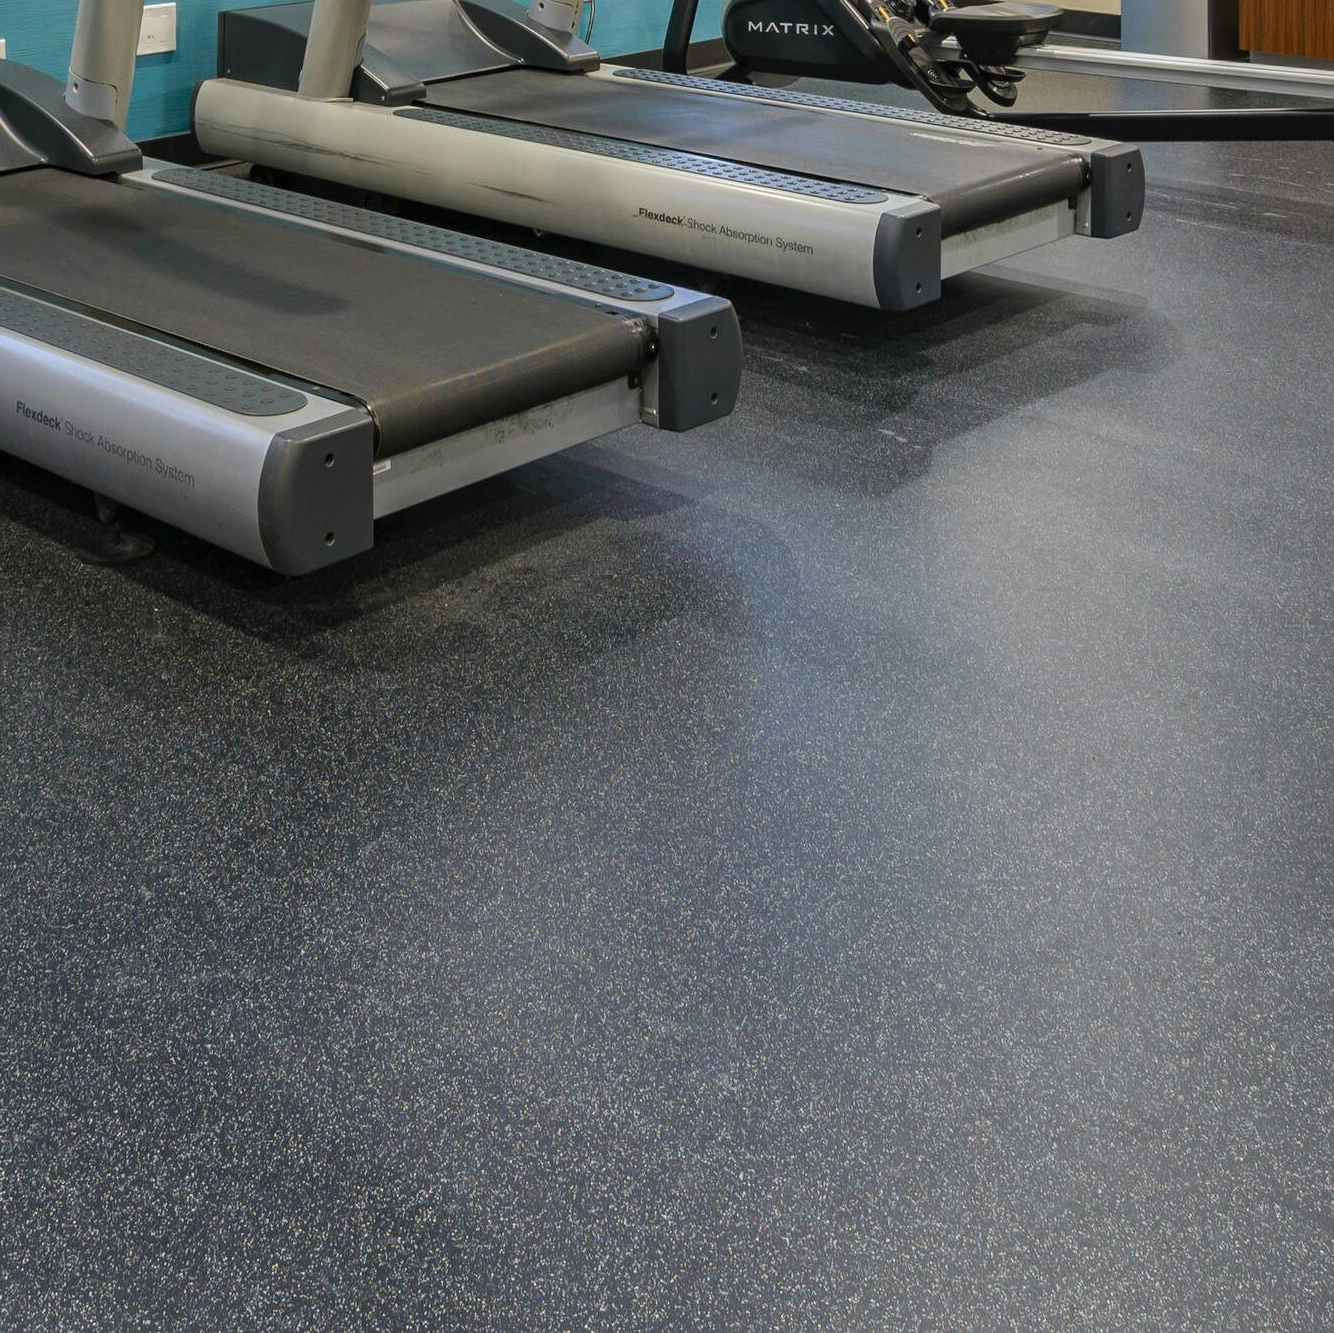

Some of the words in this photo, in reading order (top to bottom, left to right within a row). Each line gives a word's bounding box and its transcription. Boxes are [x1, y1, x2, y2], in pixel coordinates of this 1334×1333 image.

[747, 20, 835, 36] MATRIX
[638, 207, 684, 227] Flexdeck
[687, 217, 717, 235] Shock
[719, 224, 773, 247] Absorption
[775, 236, 814, 255] System
[15, 399, 62, 432] Flexdeck
[65, 418, 95, 446] Shock
[97, 434, 153, 470] Absorption
[155, 457, 195, 488] System
